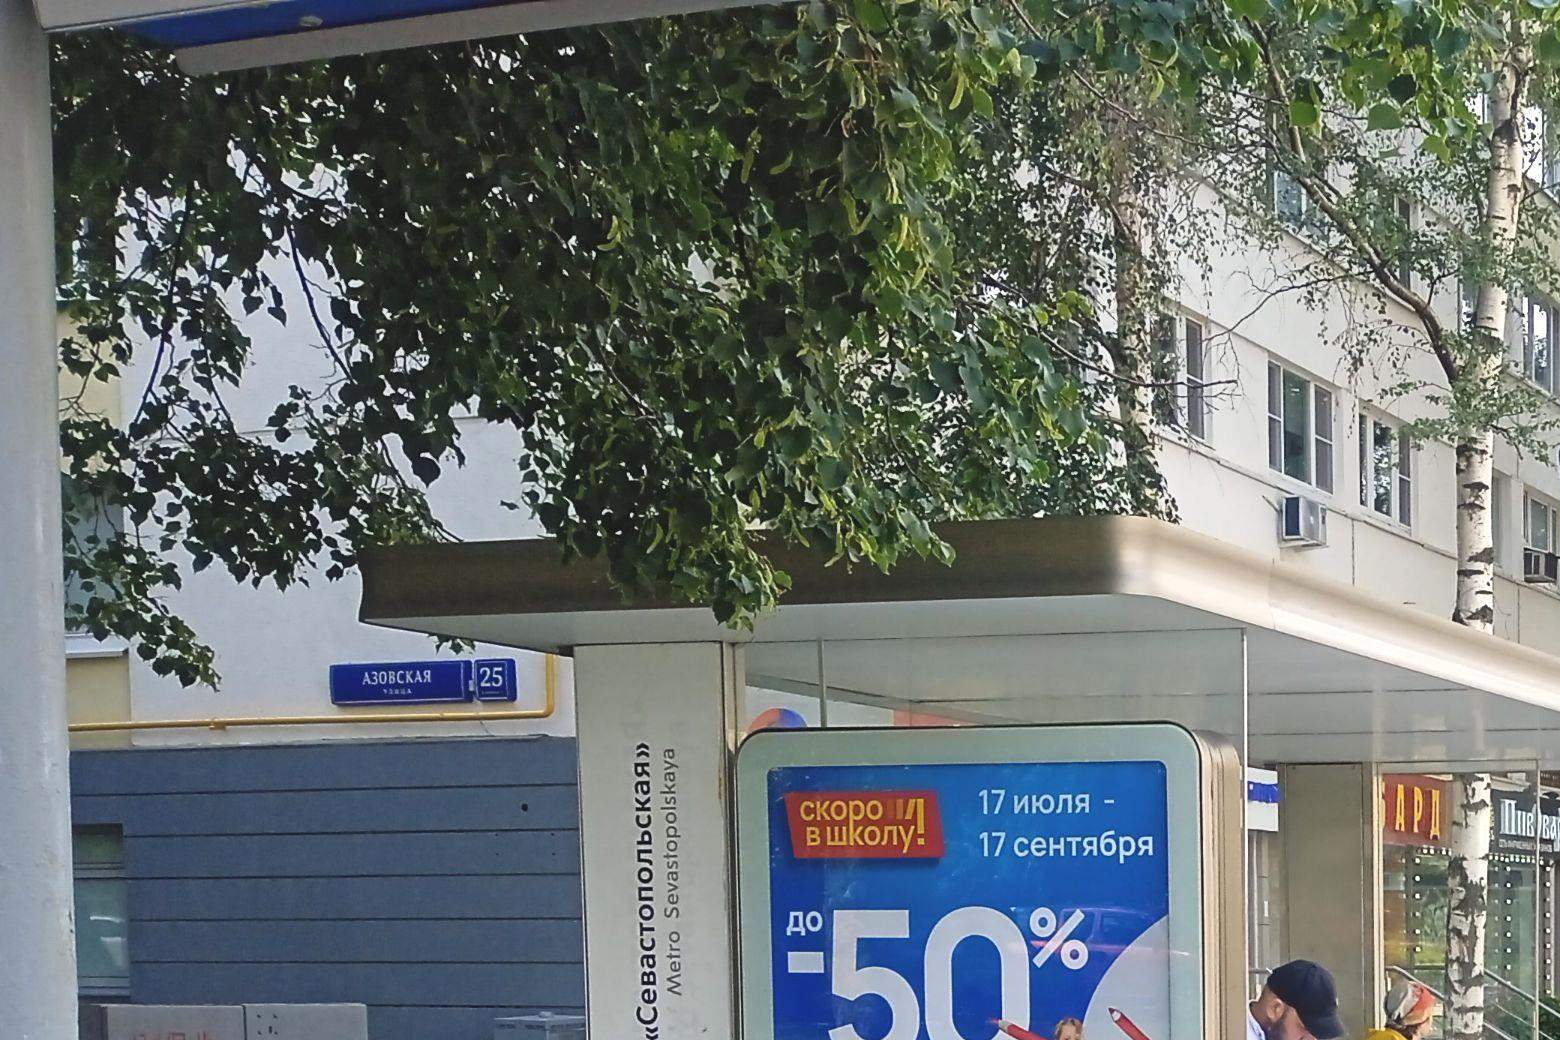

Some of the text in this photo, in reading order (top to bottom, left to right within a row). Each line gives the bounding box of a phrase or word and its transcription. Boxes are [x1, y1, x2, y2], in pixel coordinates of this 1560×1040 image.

[362, 669, 432, 686] АЗОВСКАЯ
[479, 667, 503, 687] 25
[800, 799, 883, 823] скоро
[978, 789, 1006, 815] 17
[1013, 793, 1091, 815] июля
[806, 826, 821, 846] в
[979, 830, 1155, 864] 17 сентября
[660, 747, 683, 997] Metro Sevastopolskaya
[786, 911, 824, 937] до
